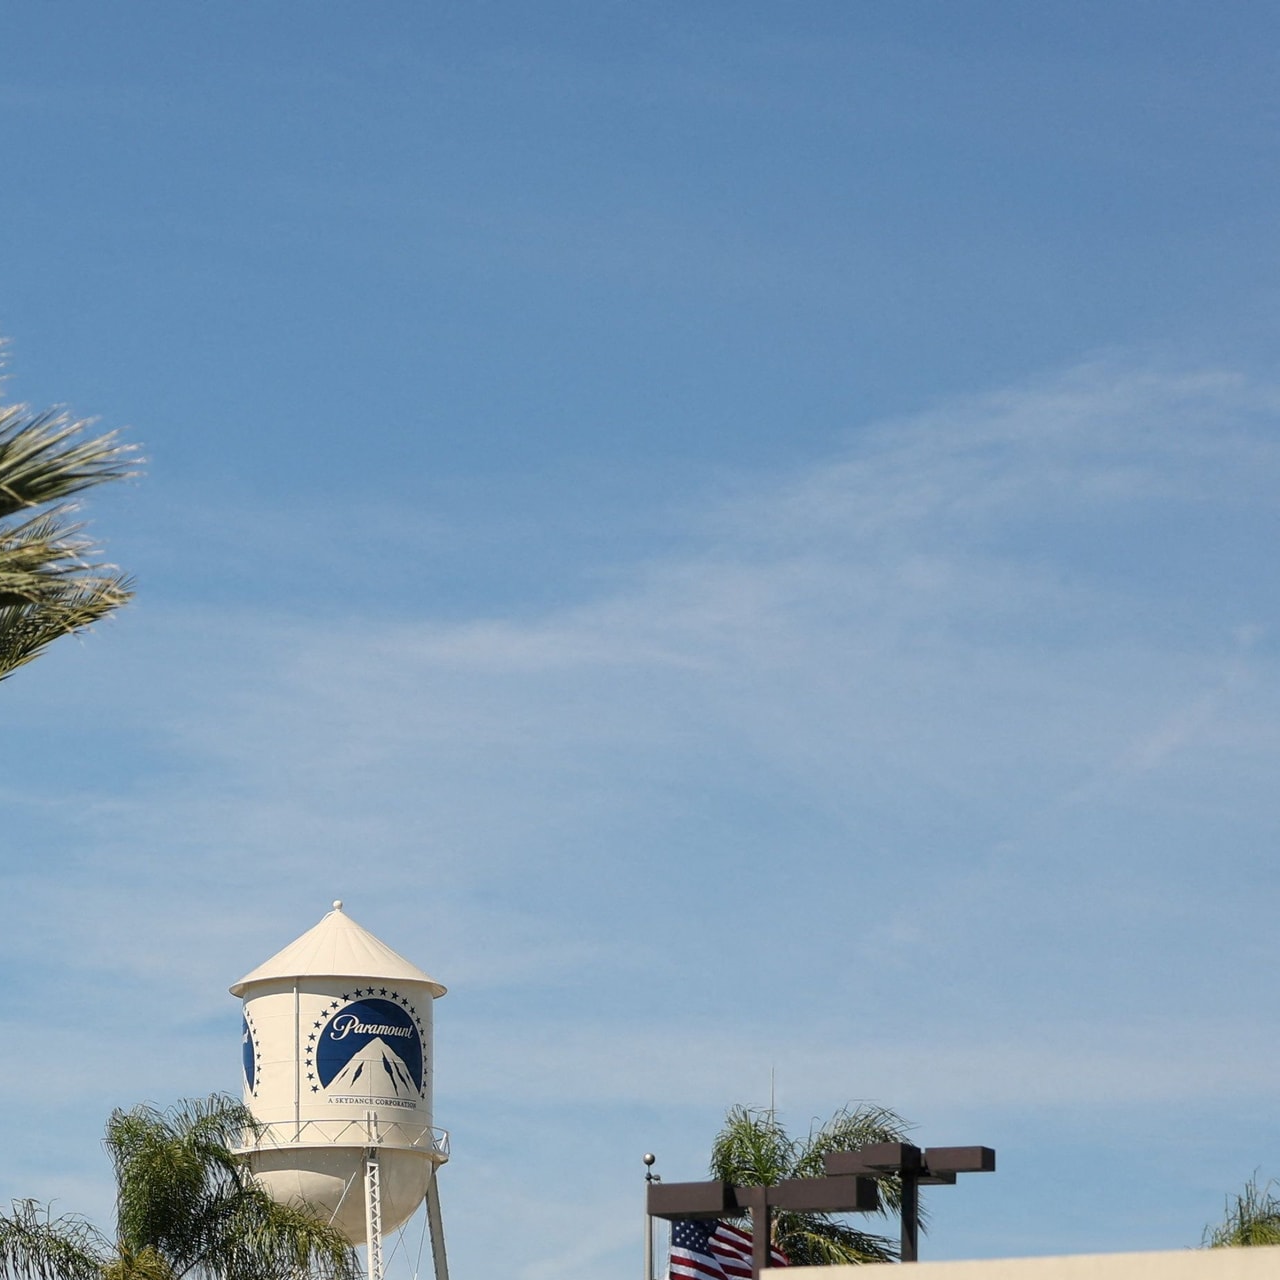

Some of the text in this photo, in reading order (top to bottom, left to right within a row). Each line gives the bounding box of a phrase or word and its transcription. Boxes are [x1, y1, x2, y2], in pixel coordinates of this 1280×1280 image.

[330, 1014, 413, 1040] Paramount
[335, 1097, 374, 1105] SKYDANCE
[375, 1098, 417, 1109] CORPORATION
